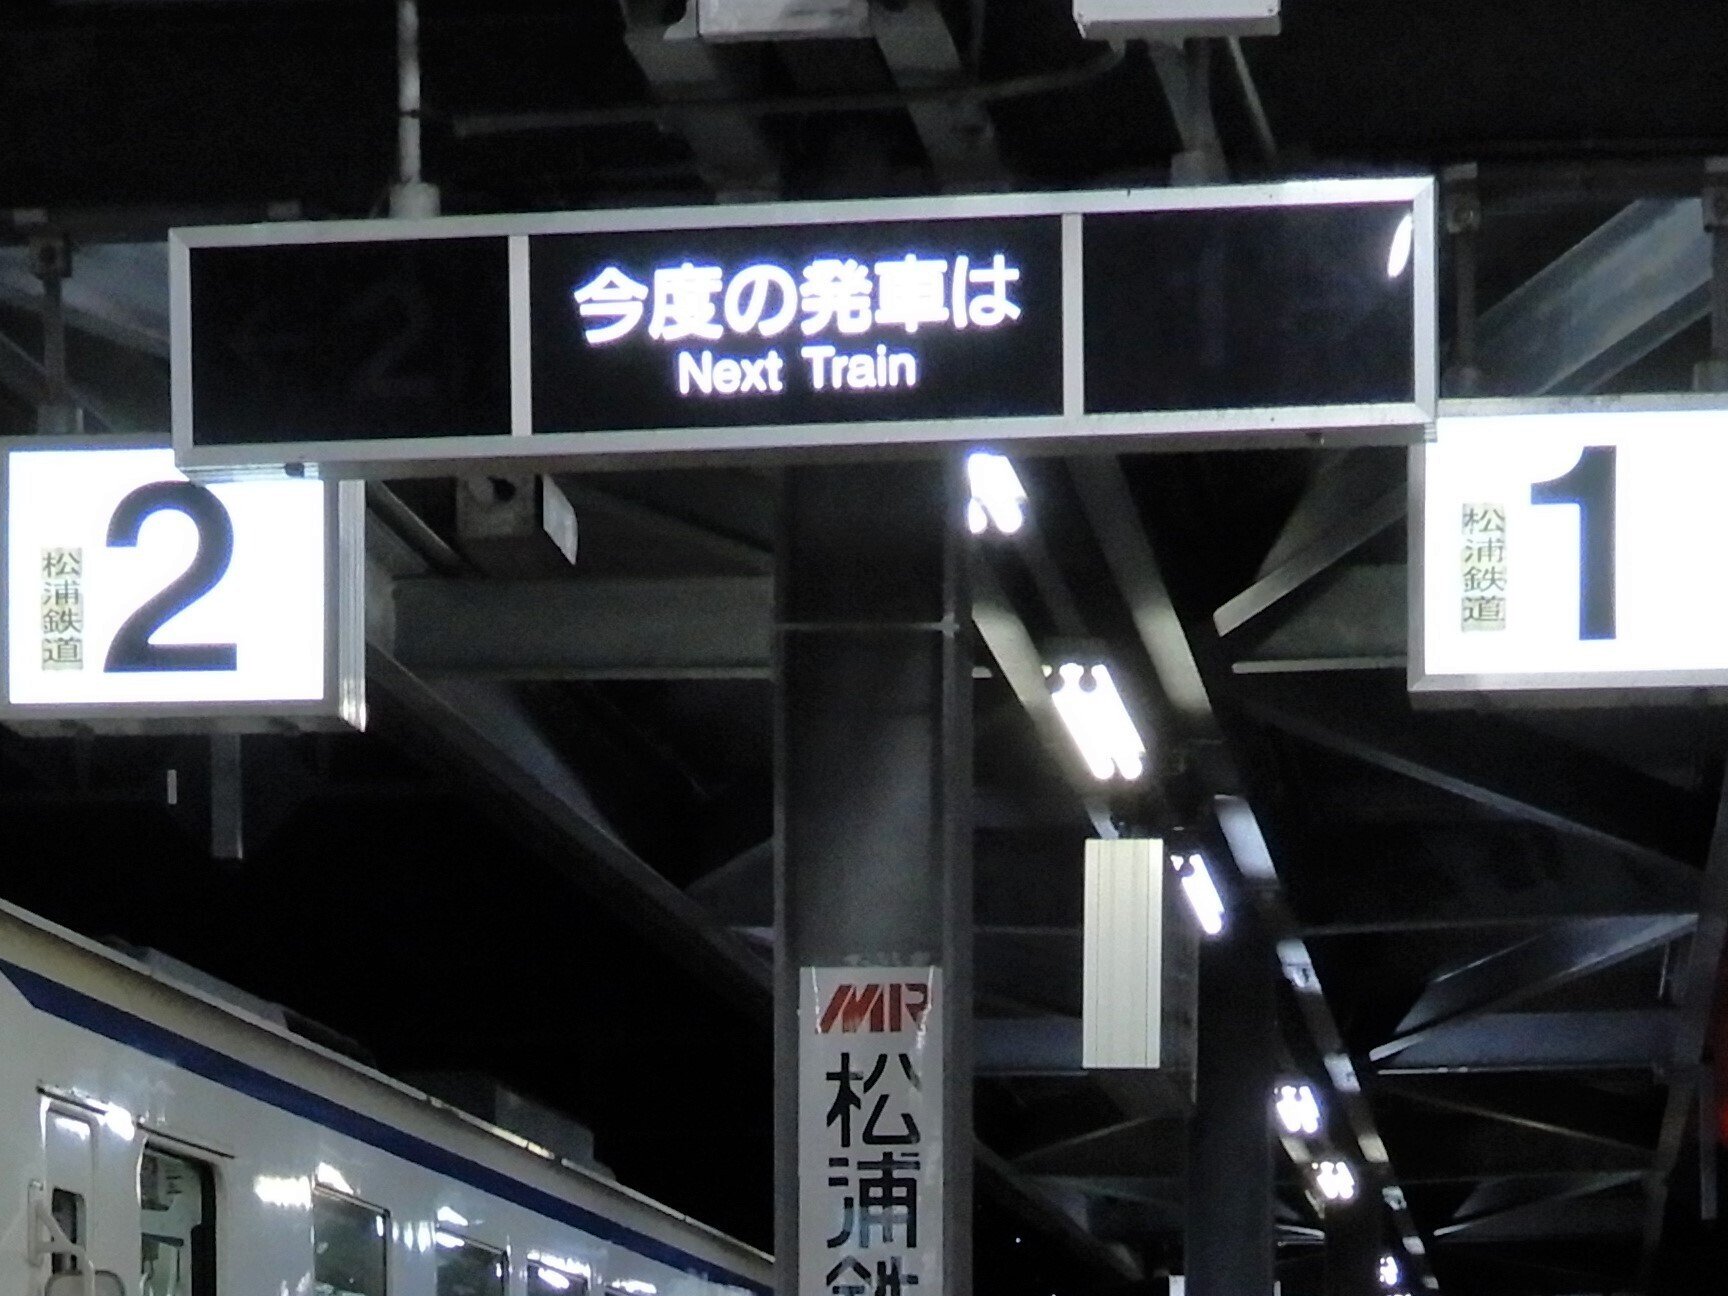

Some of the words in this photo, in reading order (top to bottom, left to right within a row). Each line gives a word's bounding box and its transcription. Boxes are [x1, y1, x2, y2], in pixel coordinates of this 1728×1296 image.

[573, 253, 1022, 344] 今度の発車は
[678, 349, 783, 395] Next
[800, 343, 917, 390] Train
[104, 480, 238, 673] 2
[1462, 506, 1506, 623] 松浦鉄道
[1531, 445, 1617, 640] 1
[42, 550, 82, 665] 松浦鉄道
[816, 982, 934, 1034] MR
